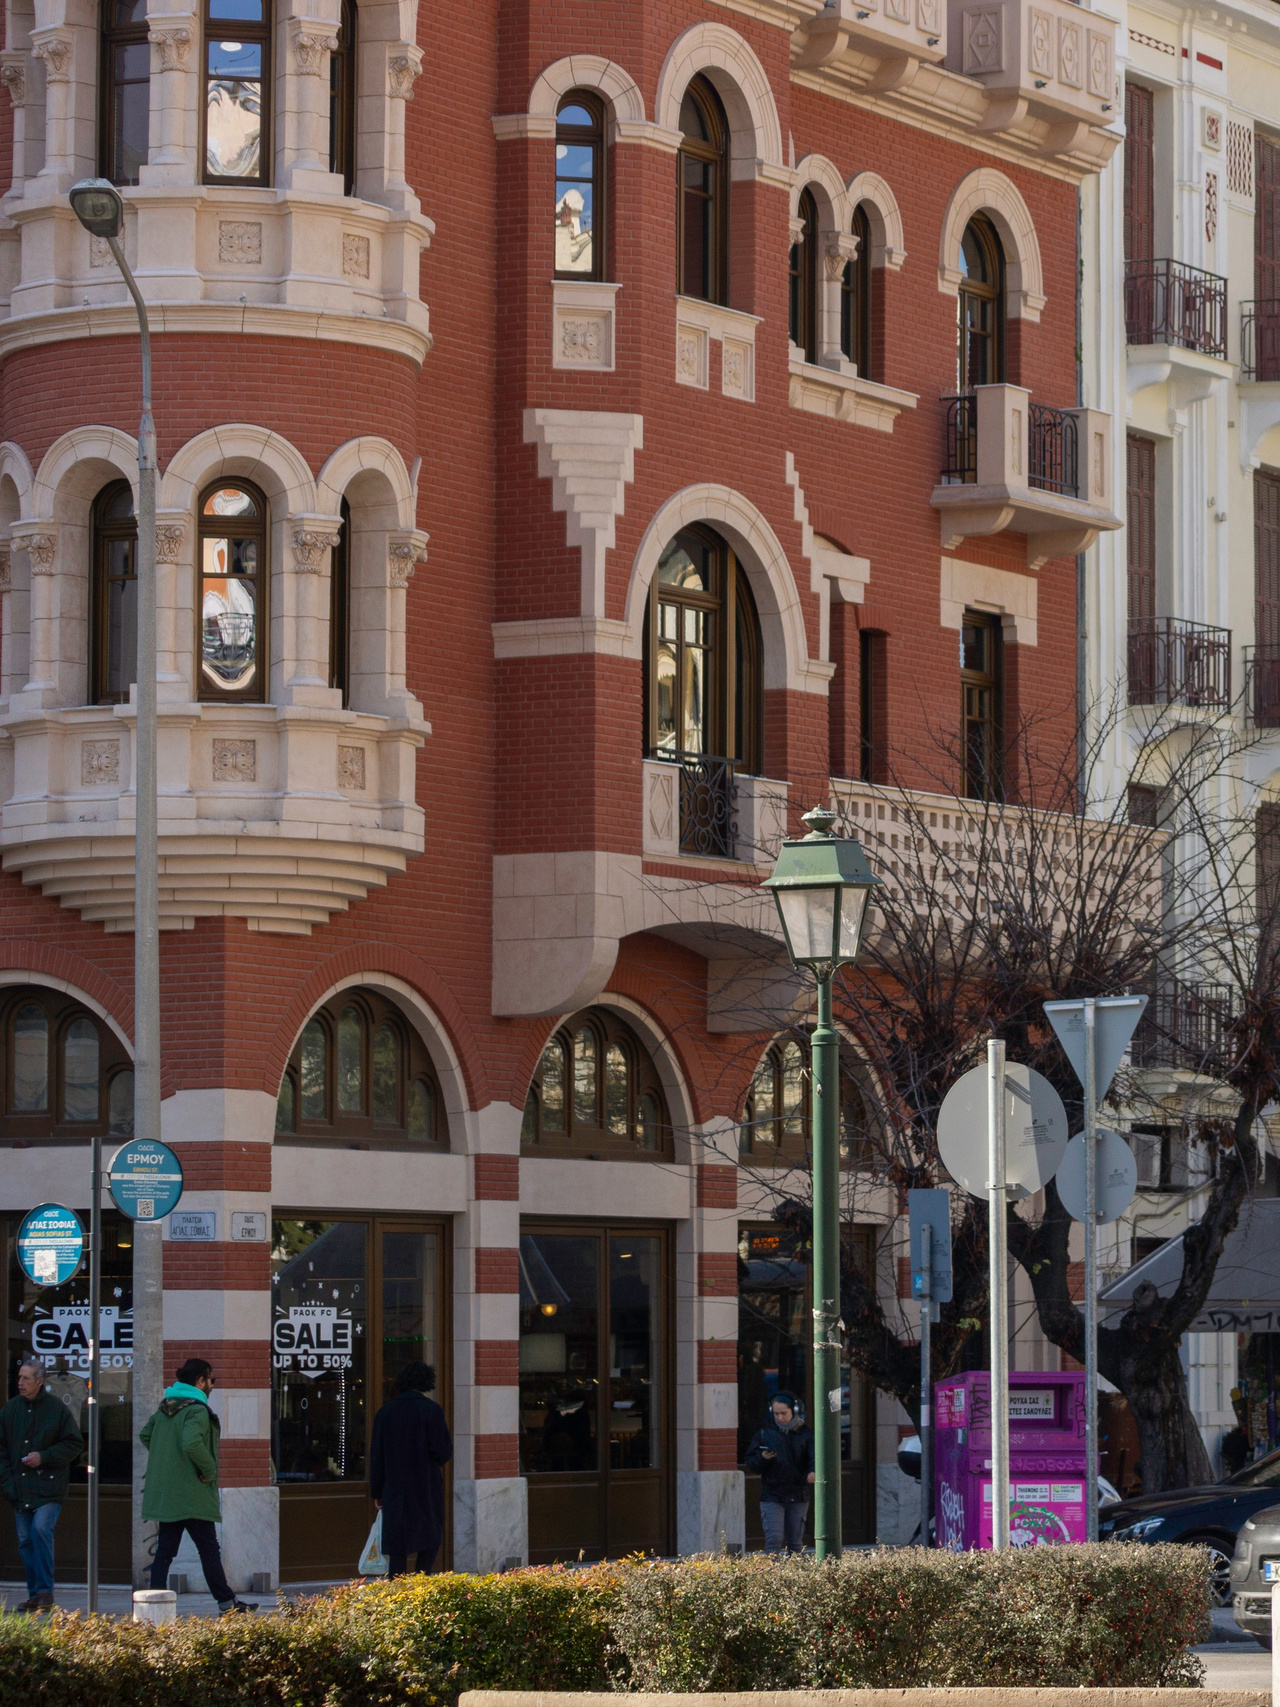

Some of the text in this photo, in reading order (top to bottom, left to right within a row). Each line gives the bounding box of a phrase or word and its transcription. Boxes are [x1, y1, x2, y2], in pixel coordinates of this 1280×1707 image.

[127, 1153, 165, 1164] ΕΡΜΟΥ
[48, 1220, 76, 1228] ΣΟΦΙΑΣ
[173, 1226, 210, 1236] ΑΓΙΑΣ ΣΟΦΙΑΣ
[242, 1228, 256, 1238] ΕΡΜΟΥ
[276, 1323, 348, 1349] SALE
[32, 1355, 133, 1368] P TO 50%
[273, 1355, 352, 1368] UP TO 50%
